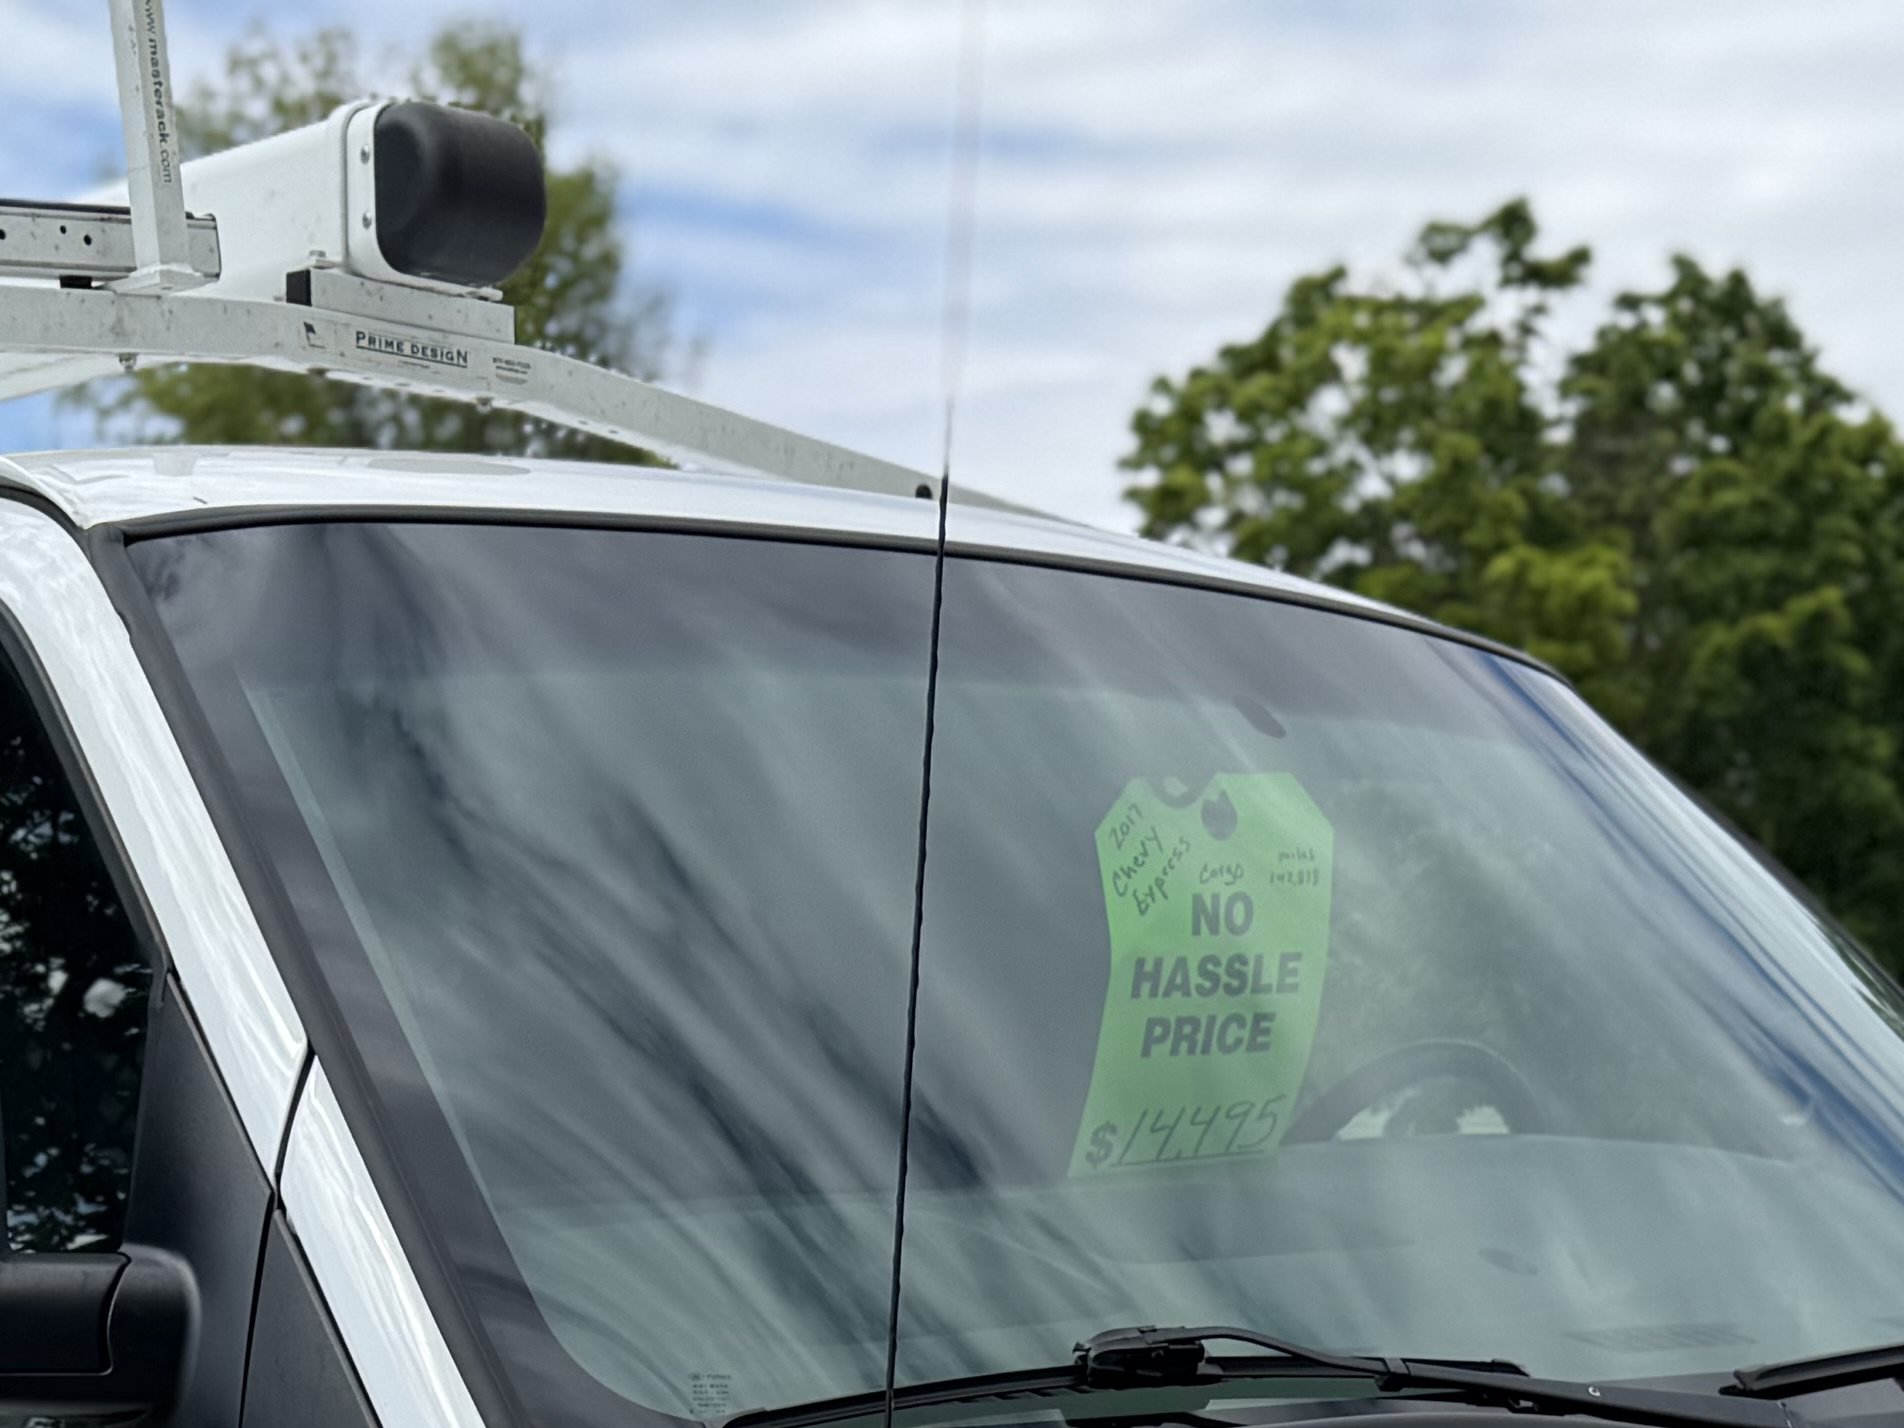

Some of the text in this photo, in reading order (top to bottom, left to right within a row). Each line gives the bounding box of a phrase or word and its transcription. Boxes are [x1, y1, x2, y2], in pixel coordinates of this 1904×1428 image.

[356, 330, 404, 354] PRIME
[411, 342, 467, 364] DESIGN
[1110, 803, 1143, 849] 2017
[1112, 826, 1164, 898] Chevy
[1199, 863, 1244, 886] Cargo
[1191, 891, 1254, 937] NO
[1131, 951, 1303, 999] HASSLE
[1140, 1011, 1276, 1059] PRICE
